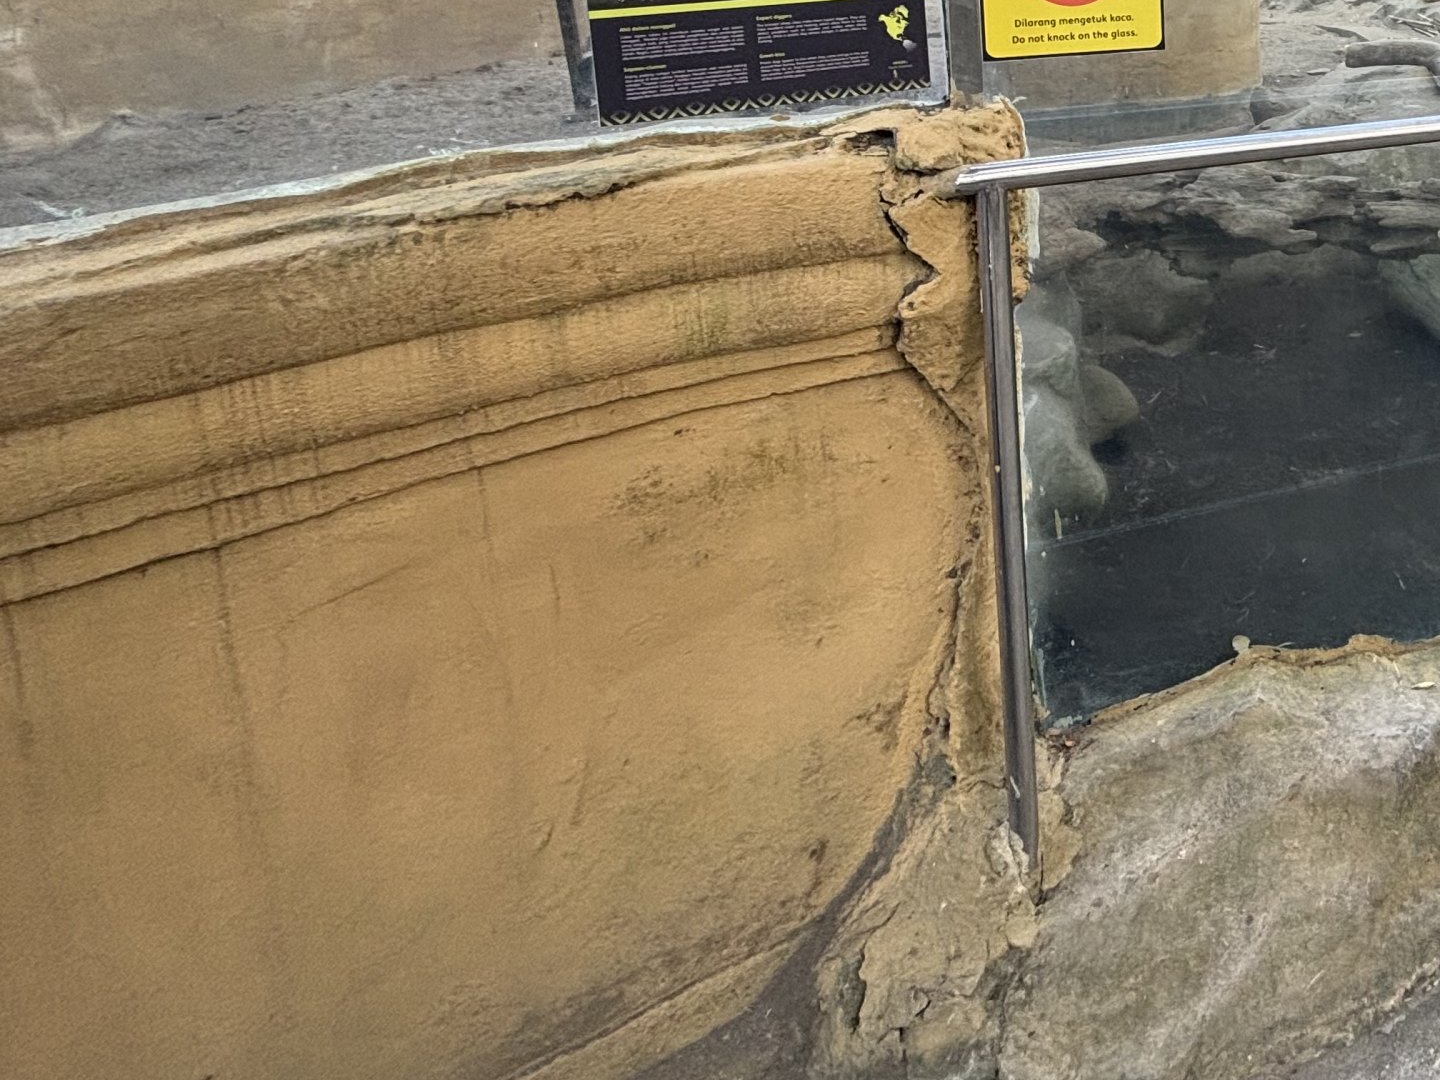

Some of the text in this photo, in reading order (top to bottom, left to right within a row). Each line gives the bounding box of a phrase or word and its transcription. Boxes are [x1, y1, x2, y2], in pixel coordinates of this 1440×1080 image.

[1014, 13, 1135, 28] Dilarang mengetuk kaca.
[1012, 35, 1026, 45] Do
[1027, 34, 1045, 43] not
[1047, 32, 1075, 42] knock
[1092, 30, 1109, 39] the
[1110, 29, 1138, 41] glass.
